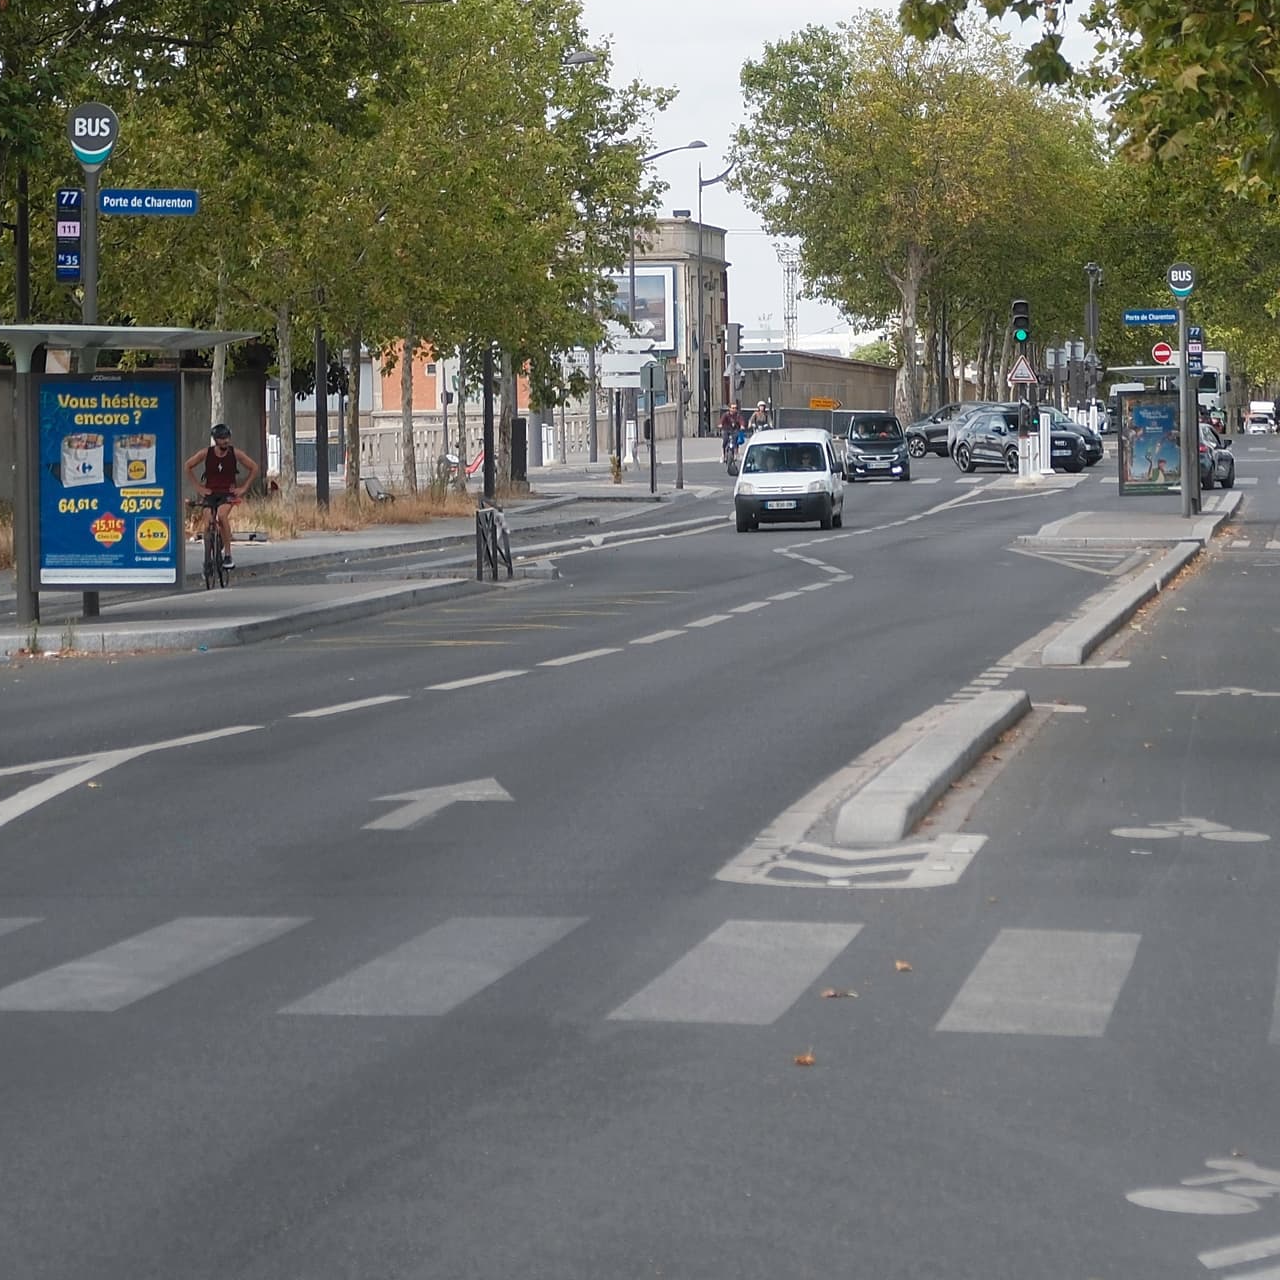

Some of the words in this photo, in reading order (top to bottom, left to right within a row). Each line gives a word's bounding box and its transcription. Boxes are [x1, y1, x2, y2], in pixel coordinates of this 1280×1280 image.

[74, 117, 111, 137] BUS
[60, 191, 78, 205] 77
[103, 196, 128, 208] Porte
[131, 196, 143, 208] de
[144, 196, 193, 209] Charenton
[61, 225, 77, 234] 111
[1171, 270, 1192, 282] BUS
[1190, 327, 1200, 335] 77
[58, 394, 98, 409] Vous
[101, 393, 158, 409] hésitez
[74, 413, 130, 425] encore
